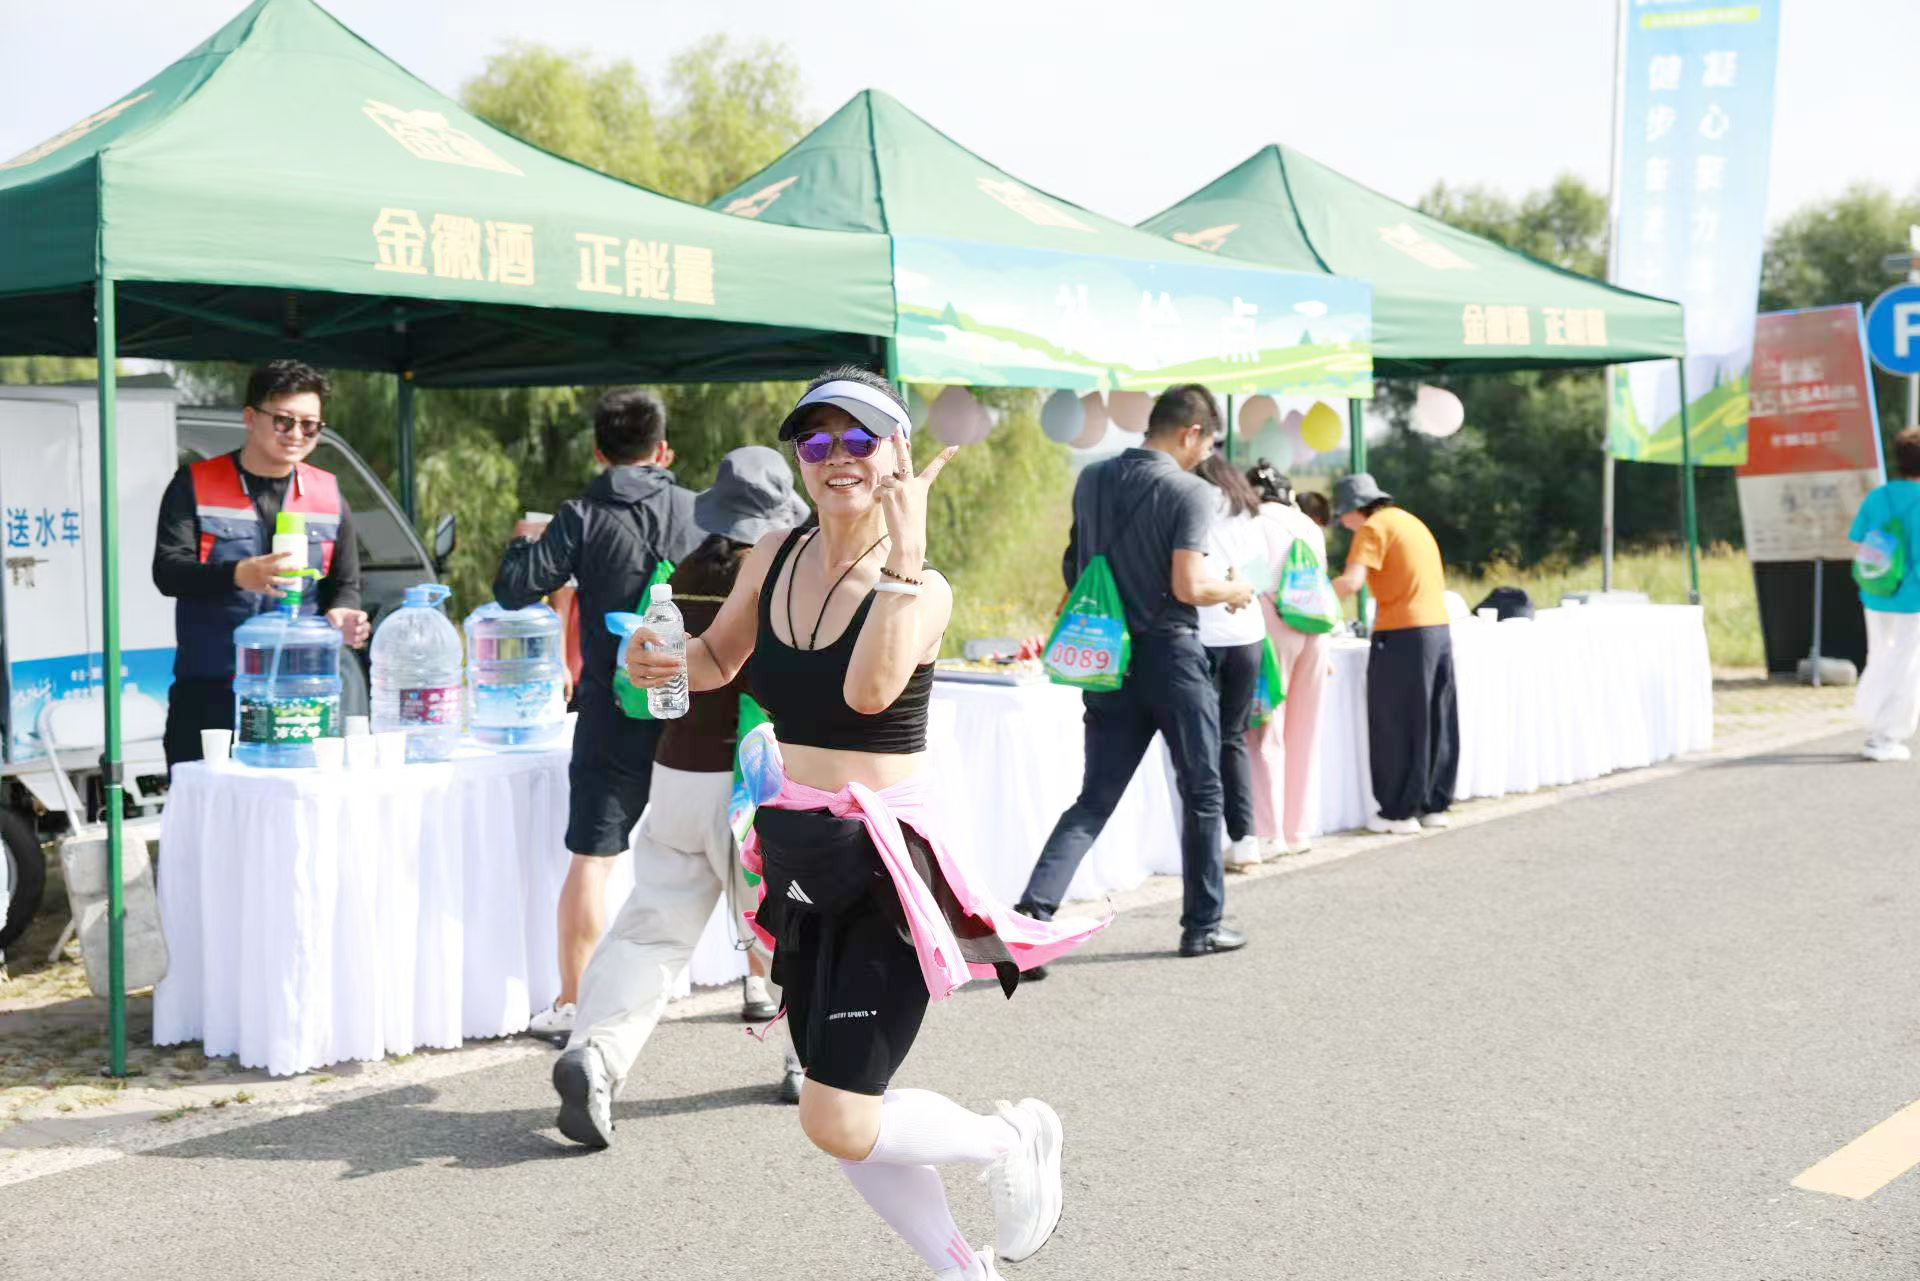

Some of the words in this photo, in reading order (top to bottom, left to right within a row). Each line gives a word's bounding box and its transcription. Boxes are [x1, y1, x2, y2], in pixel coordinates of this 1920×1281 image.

[373, 207, 534, 286] 金徽酒
[575, 232, 715, 305] 正能量
[7, 507, 80, 548] 送水车
